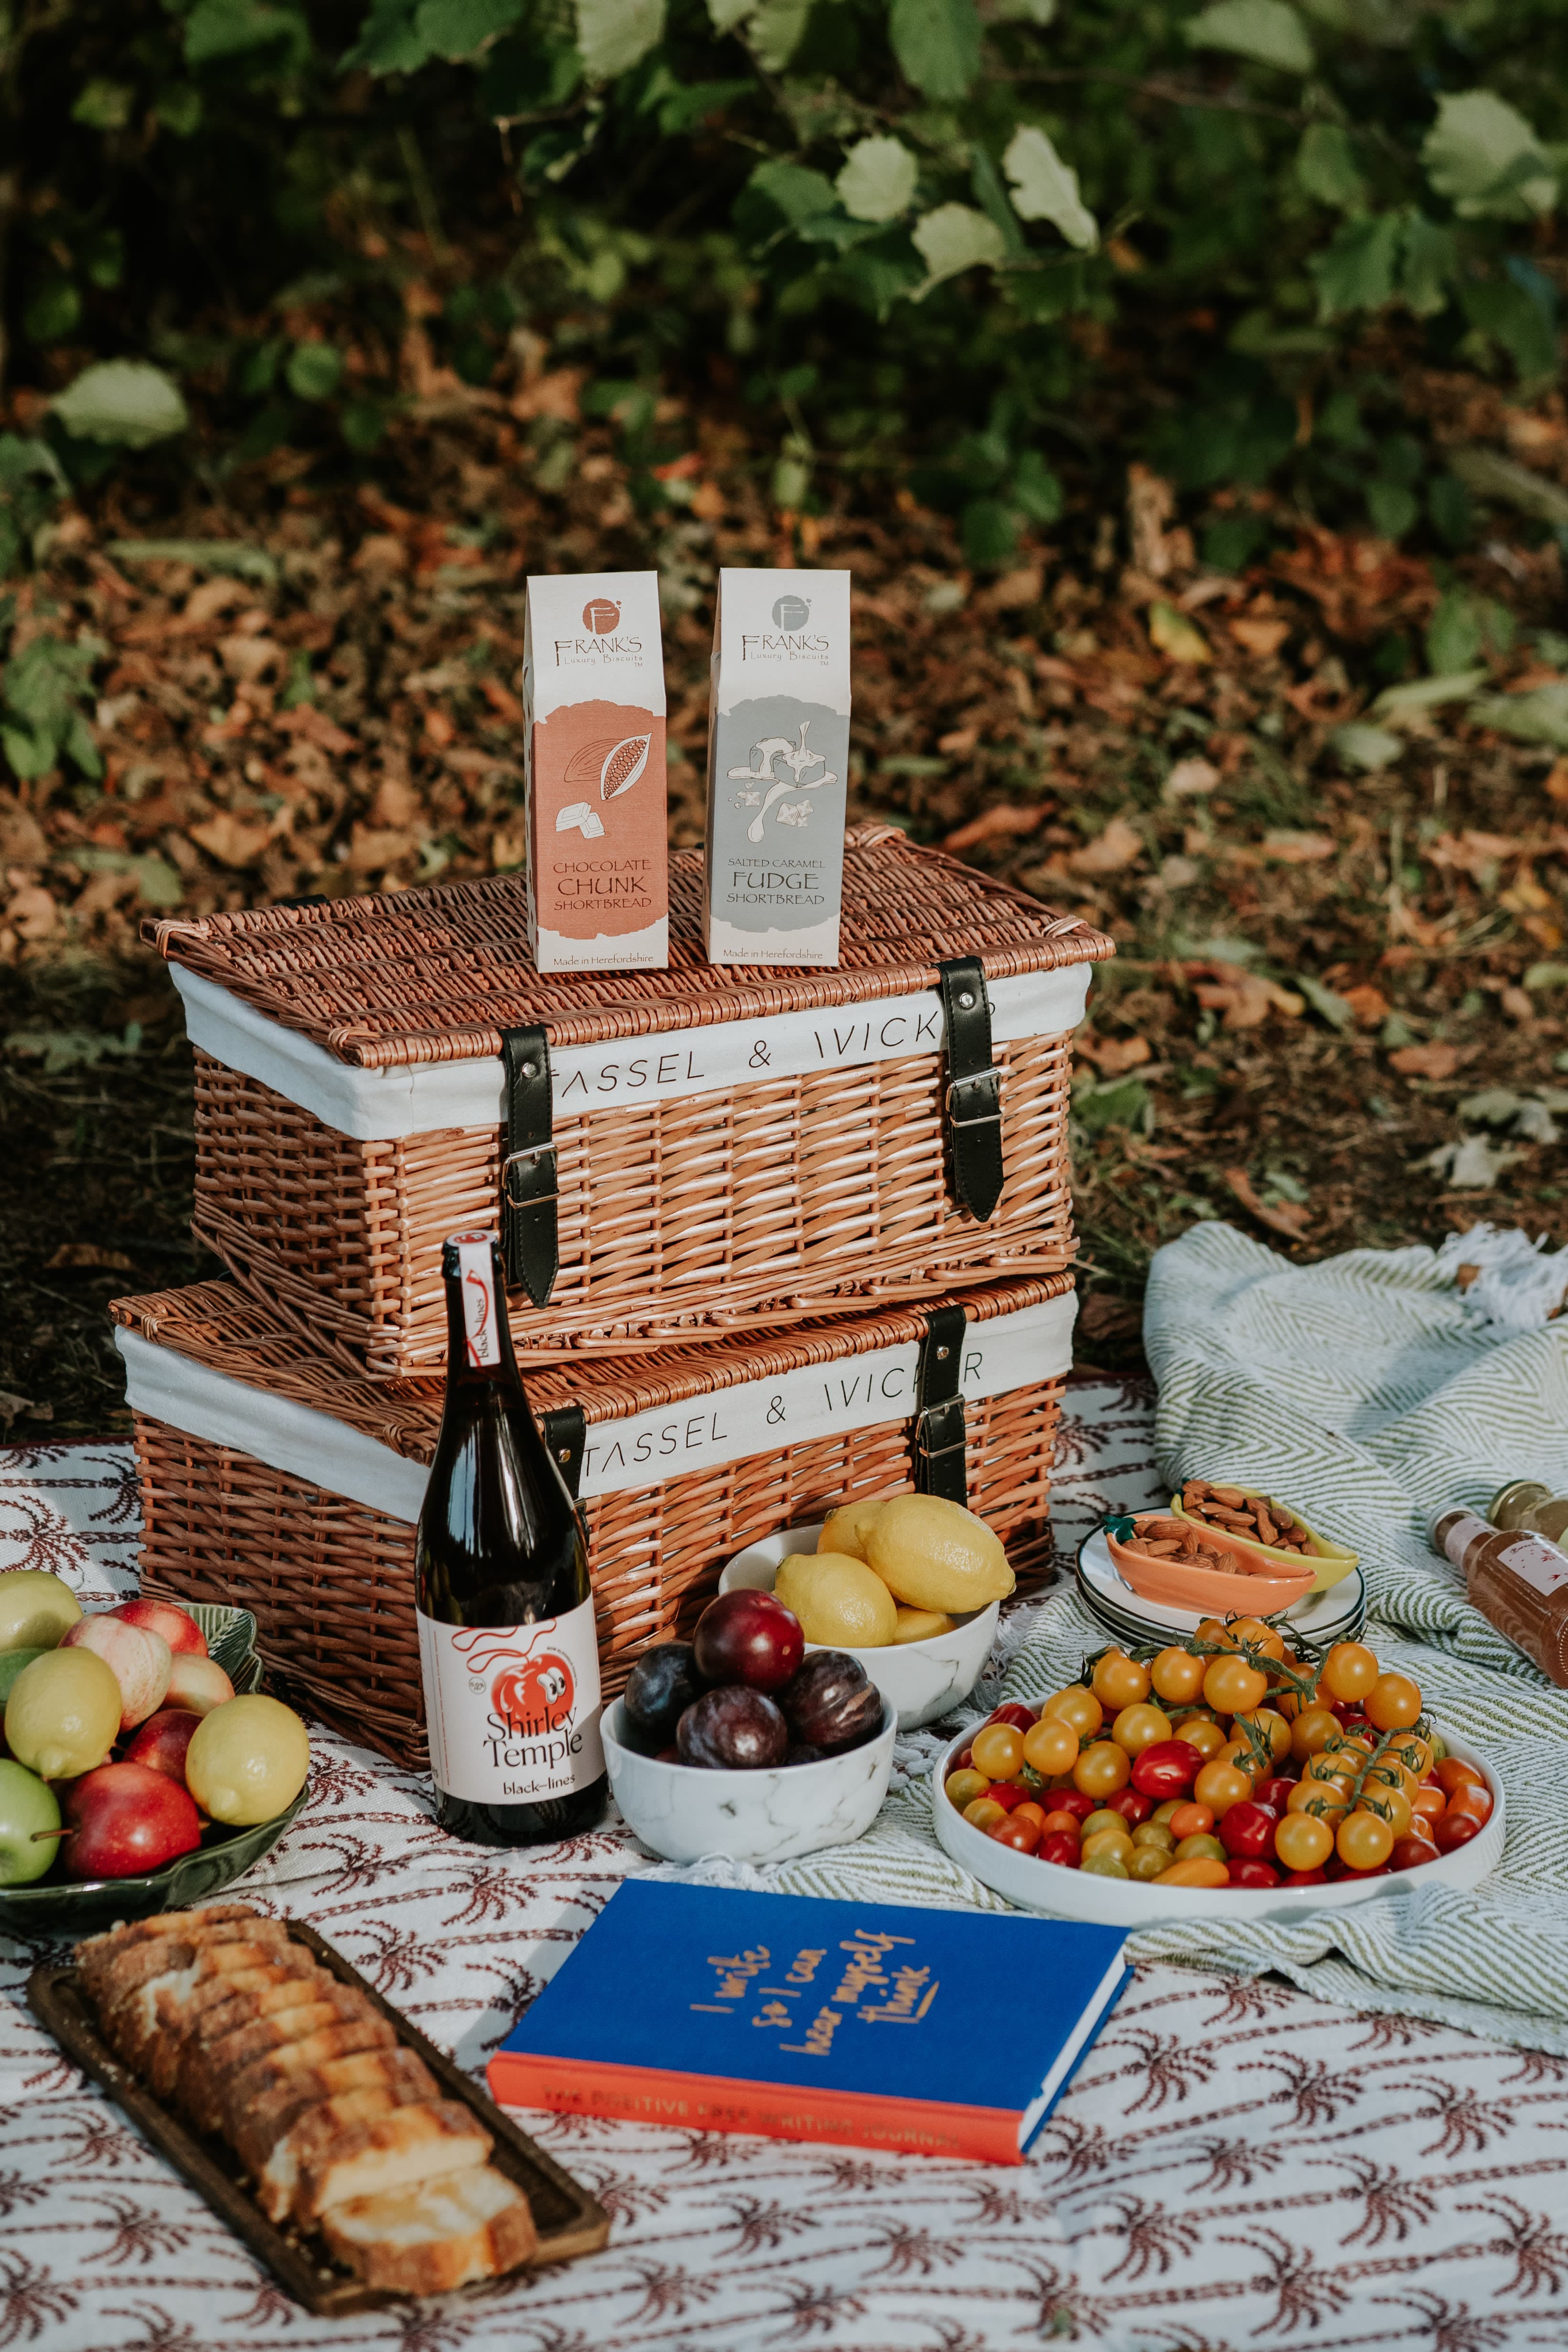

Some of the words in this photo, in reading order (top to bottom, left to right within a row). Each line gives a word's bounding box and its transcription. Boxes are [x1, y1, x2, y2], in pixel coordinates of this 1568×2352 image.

[555, 636, 642, 666] FRANK'S
[742, 634, 829, 661] FRANK'S
[564, 657, 596, 665] Luxury
[603, 654, 643, 663] Biscuits
[751, 652, 782, 661] Luxury
[789, 651, 828, 660] Biscuits
[553, 859, 652, 873] CHOCOLATE
[728, 858, 770, 867] SALTED
[772, 859, 826, 868] CARAMEL
[558, 876, 647, 895] CHUNK
[733, 872, 819, 889] FUDGE
[554, 898, 652, 911] SHORTBREAD
[727, 893, 825, 904] SHORTBREAD
[554, 956, 579, 966] Made
[591, 953, 654, 964] Herefordshire
[723, 947, 749, 957] Made
[751, 949, 759, 957] in
[761, 948, 823, 959] Herefordshire
[749, 1040, 771, 1068] &
[583, 1412, 727, 1477] TASSEL
[767, 1396, 786, 1424] &
[487, 1706, 577, 1741] Shirley
[483, 1728, 583, 1769] Temple
